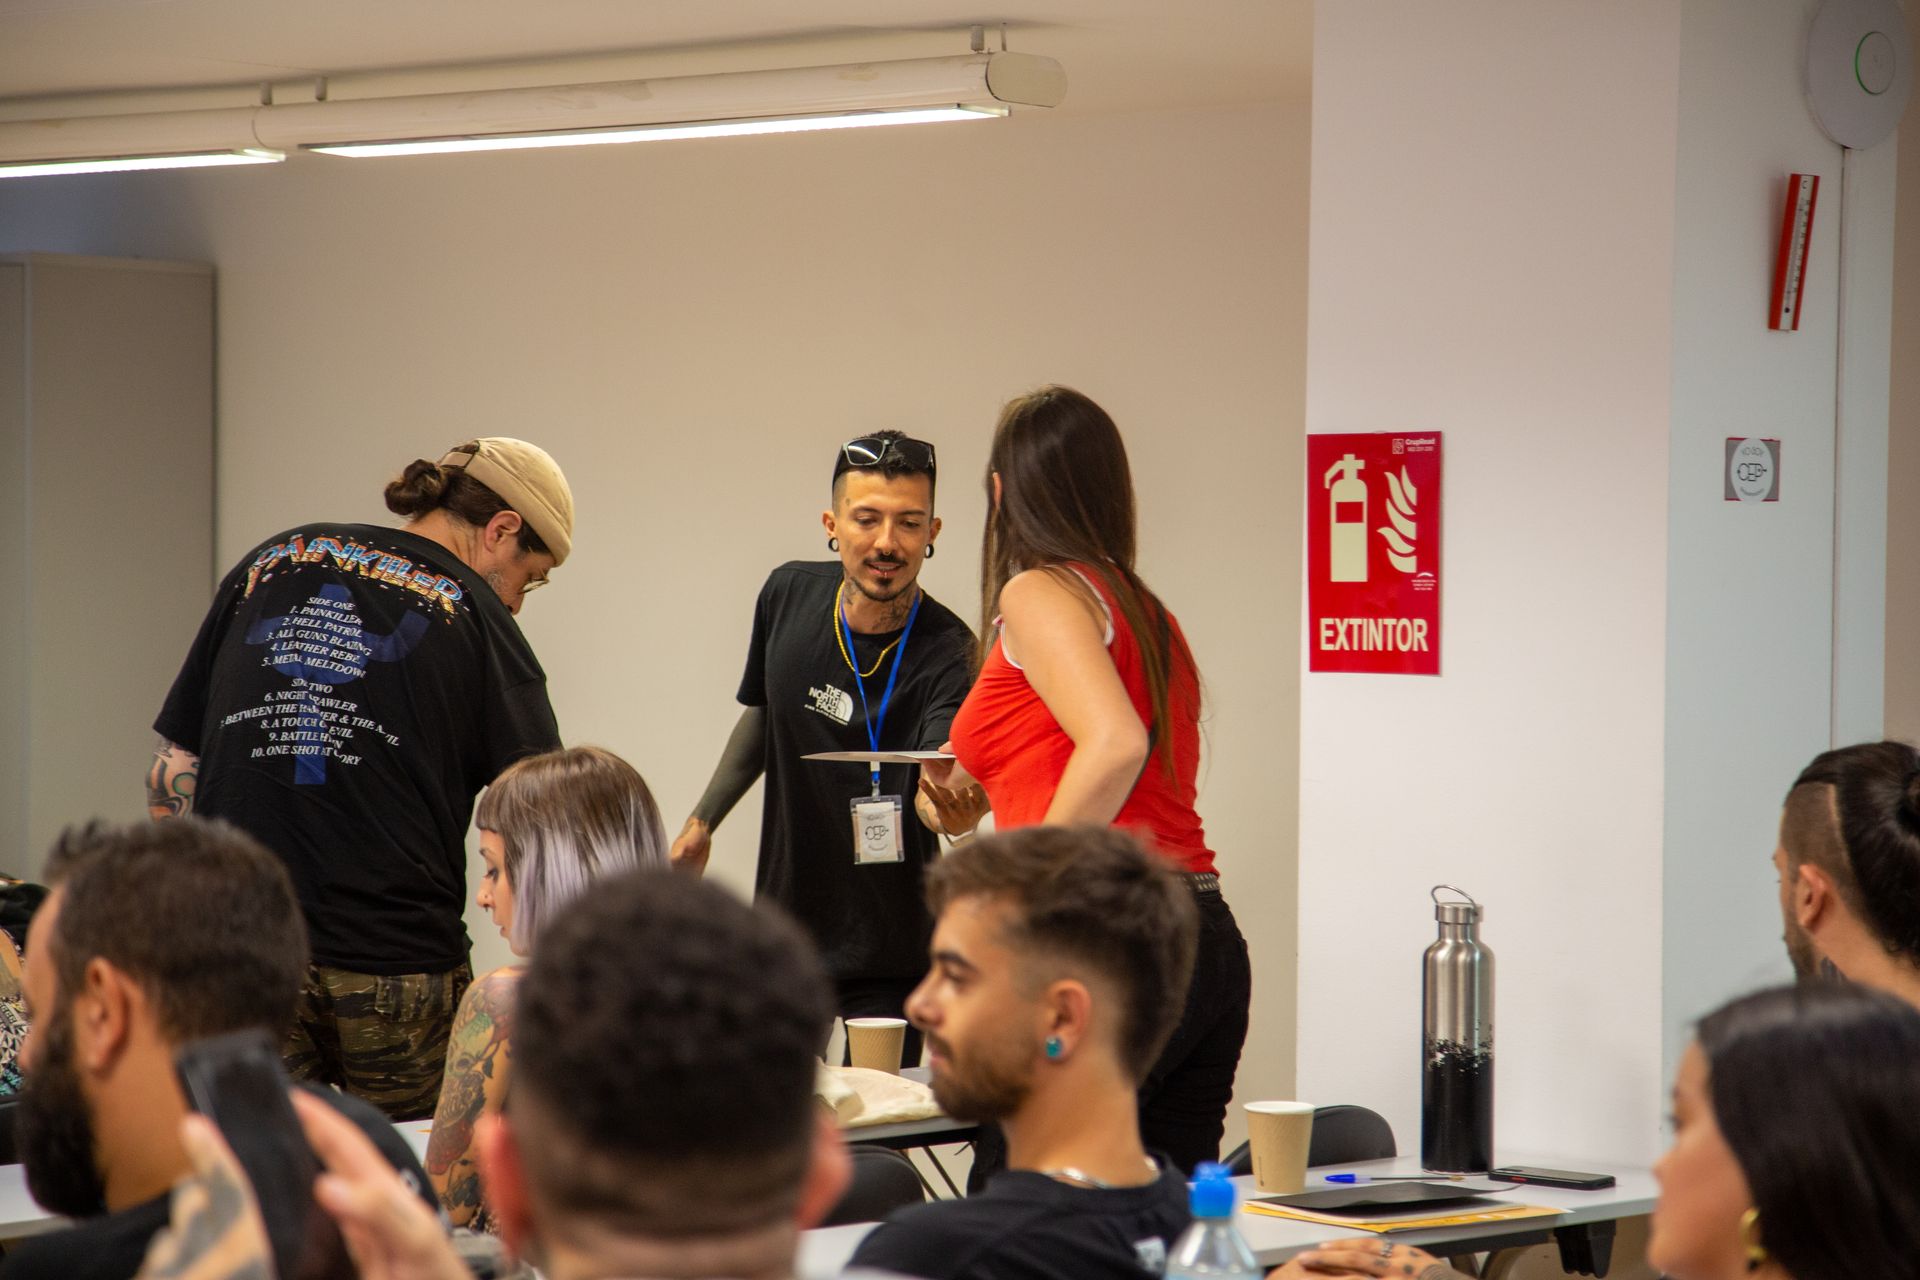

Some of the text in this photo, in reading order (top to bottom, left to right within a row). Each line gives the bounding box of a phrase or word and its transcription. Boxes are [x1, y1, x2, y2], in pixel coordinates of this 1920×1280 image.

[306, 596, 356, 611] SIDE ONE
[292, 617, 321, 628] HELL
[275, 628, 294, 639] ALL
[295, 629, 330, 642] GUNS
[1319, 617, 1429, 653] EXTINTOR
[270, 642, 280, 652] 4.
[281, 640, 330, 655] LEATHER
[260, 656, 272, 667] 5.
[308, 682, 333, 694] TWO
[826, 684, 841, 698] THE
[264, 692, 275, 702] 6.
[225, 706, 273, 725] BETWEEN
[274, 703, 298, 714] THE
[338, 714, 350, 725] &
[351, 716, 376, 731] THE
[271, 718, 281, 728] A
[281, 717, 319, 728] TOUCH
[268, 731, 279, 742] 9.
[280, 730, 321, 742] BATTLE
[250, 746, 267, 759] 10.
[265, 744, 291, 756] ONE
[290, 744, 321, 756] SHOT
